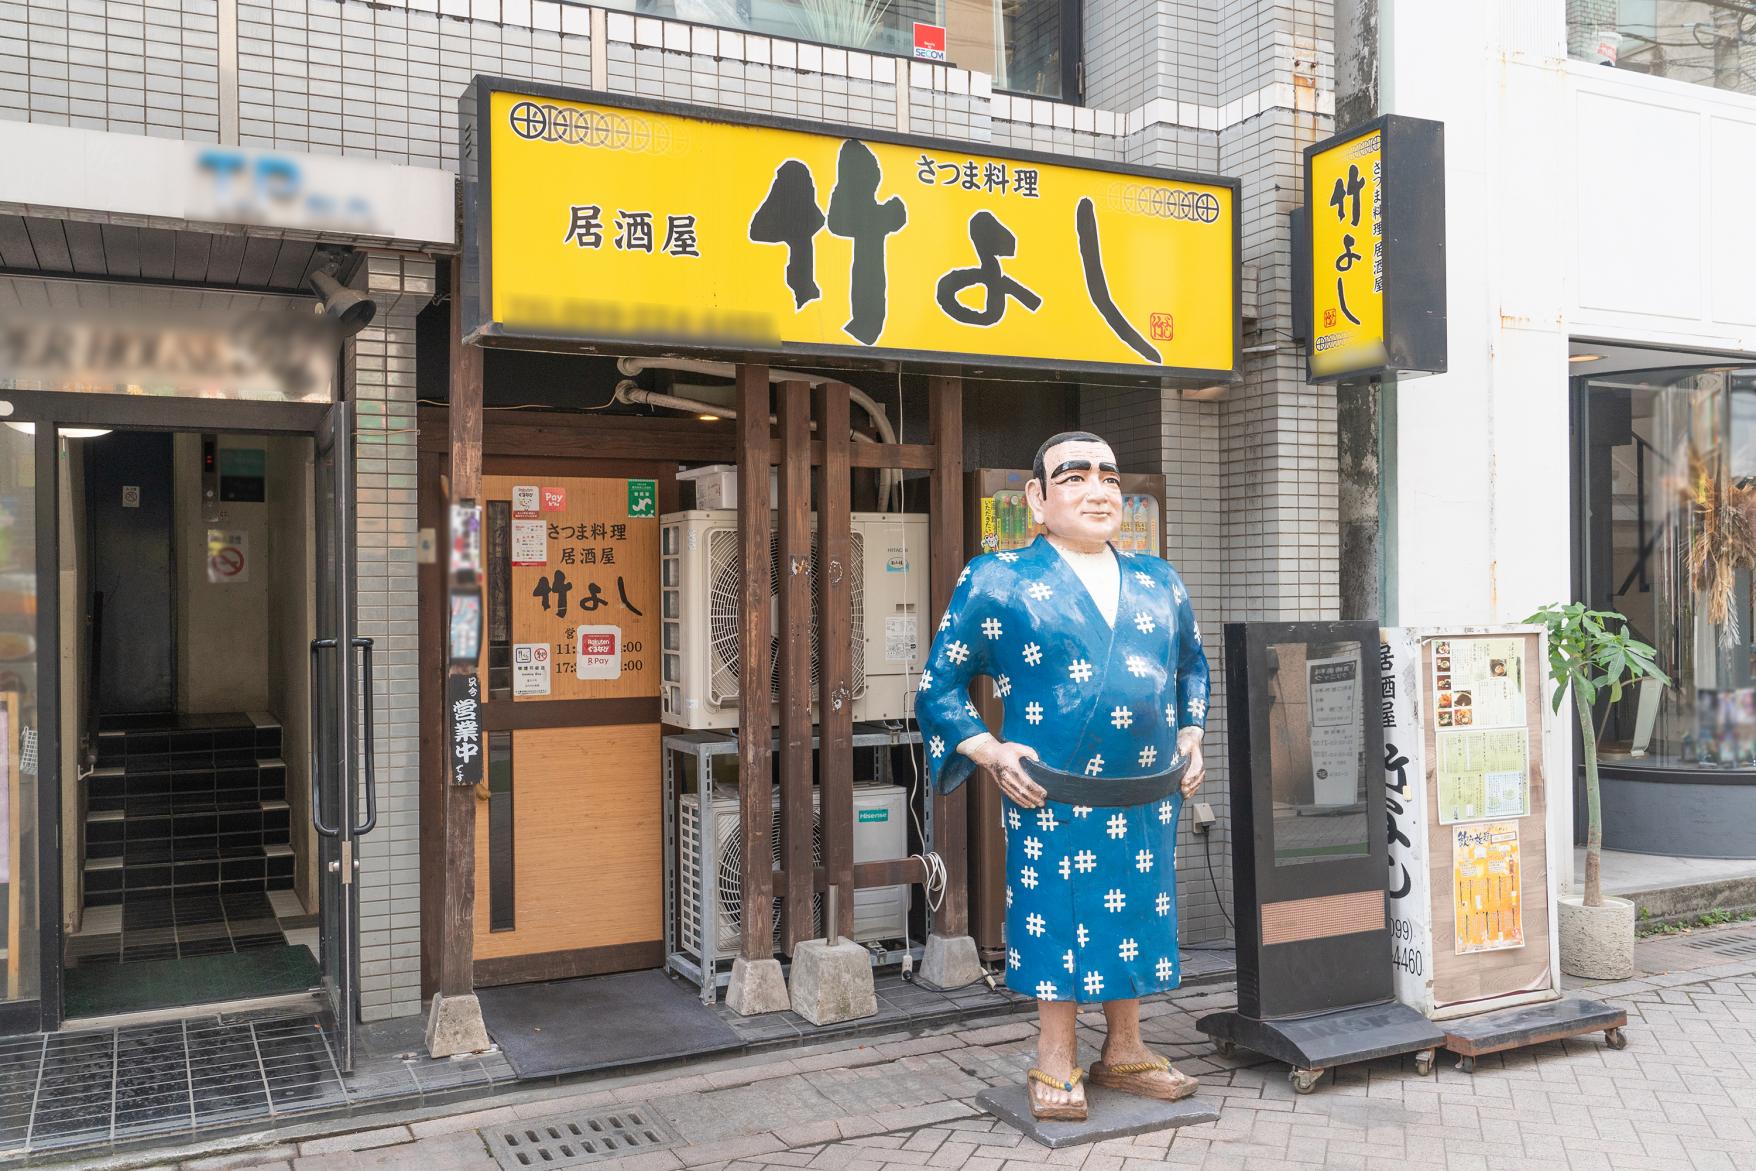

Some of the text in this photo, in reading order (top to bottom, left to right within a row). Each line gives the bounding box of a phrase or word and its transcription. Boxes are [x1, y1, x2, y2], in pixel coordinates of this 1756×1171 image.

[915, 48, 944, 60] SECOM
[917, 153, 1041, 199] さつま料理
[564, 205, 701, 257] 居酒屋
[750, 139, 1161, 363] 竹よし
[1330, 164, 1365, 325] 竹よし
[544, 492, 563, 502] Pay
[547, 523, 626, 541] さつま料理
[560, 547, 616, 565] 居酒屋
[533, 570, 643, 618] 竹よし
[620, 641, 643, 653] :00
[556, 660, 643, 674] 17: :00
[468, 677, 478, 697] 只今
[453, 698, 479, 764] 営業中
[1392, 945, 1422, 976] 4460
